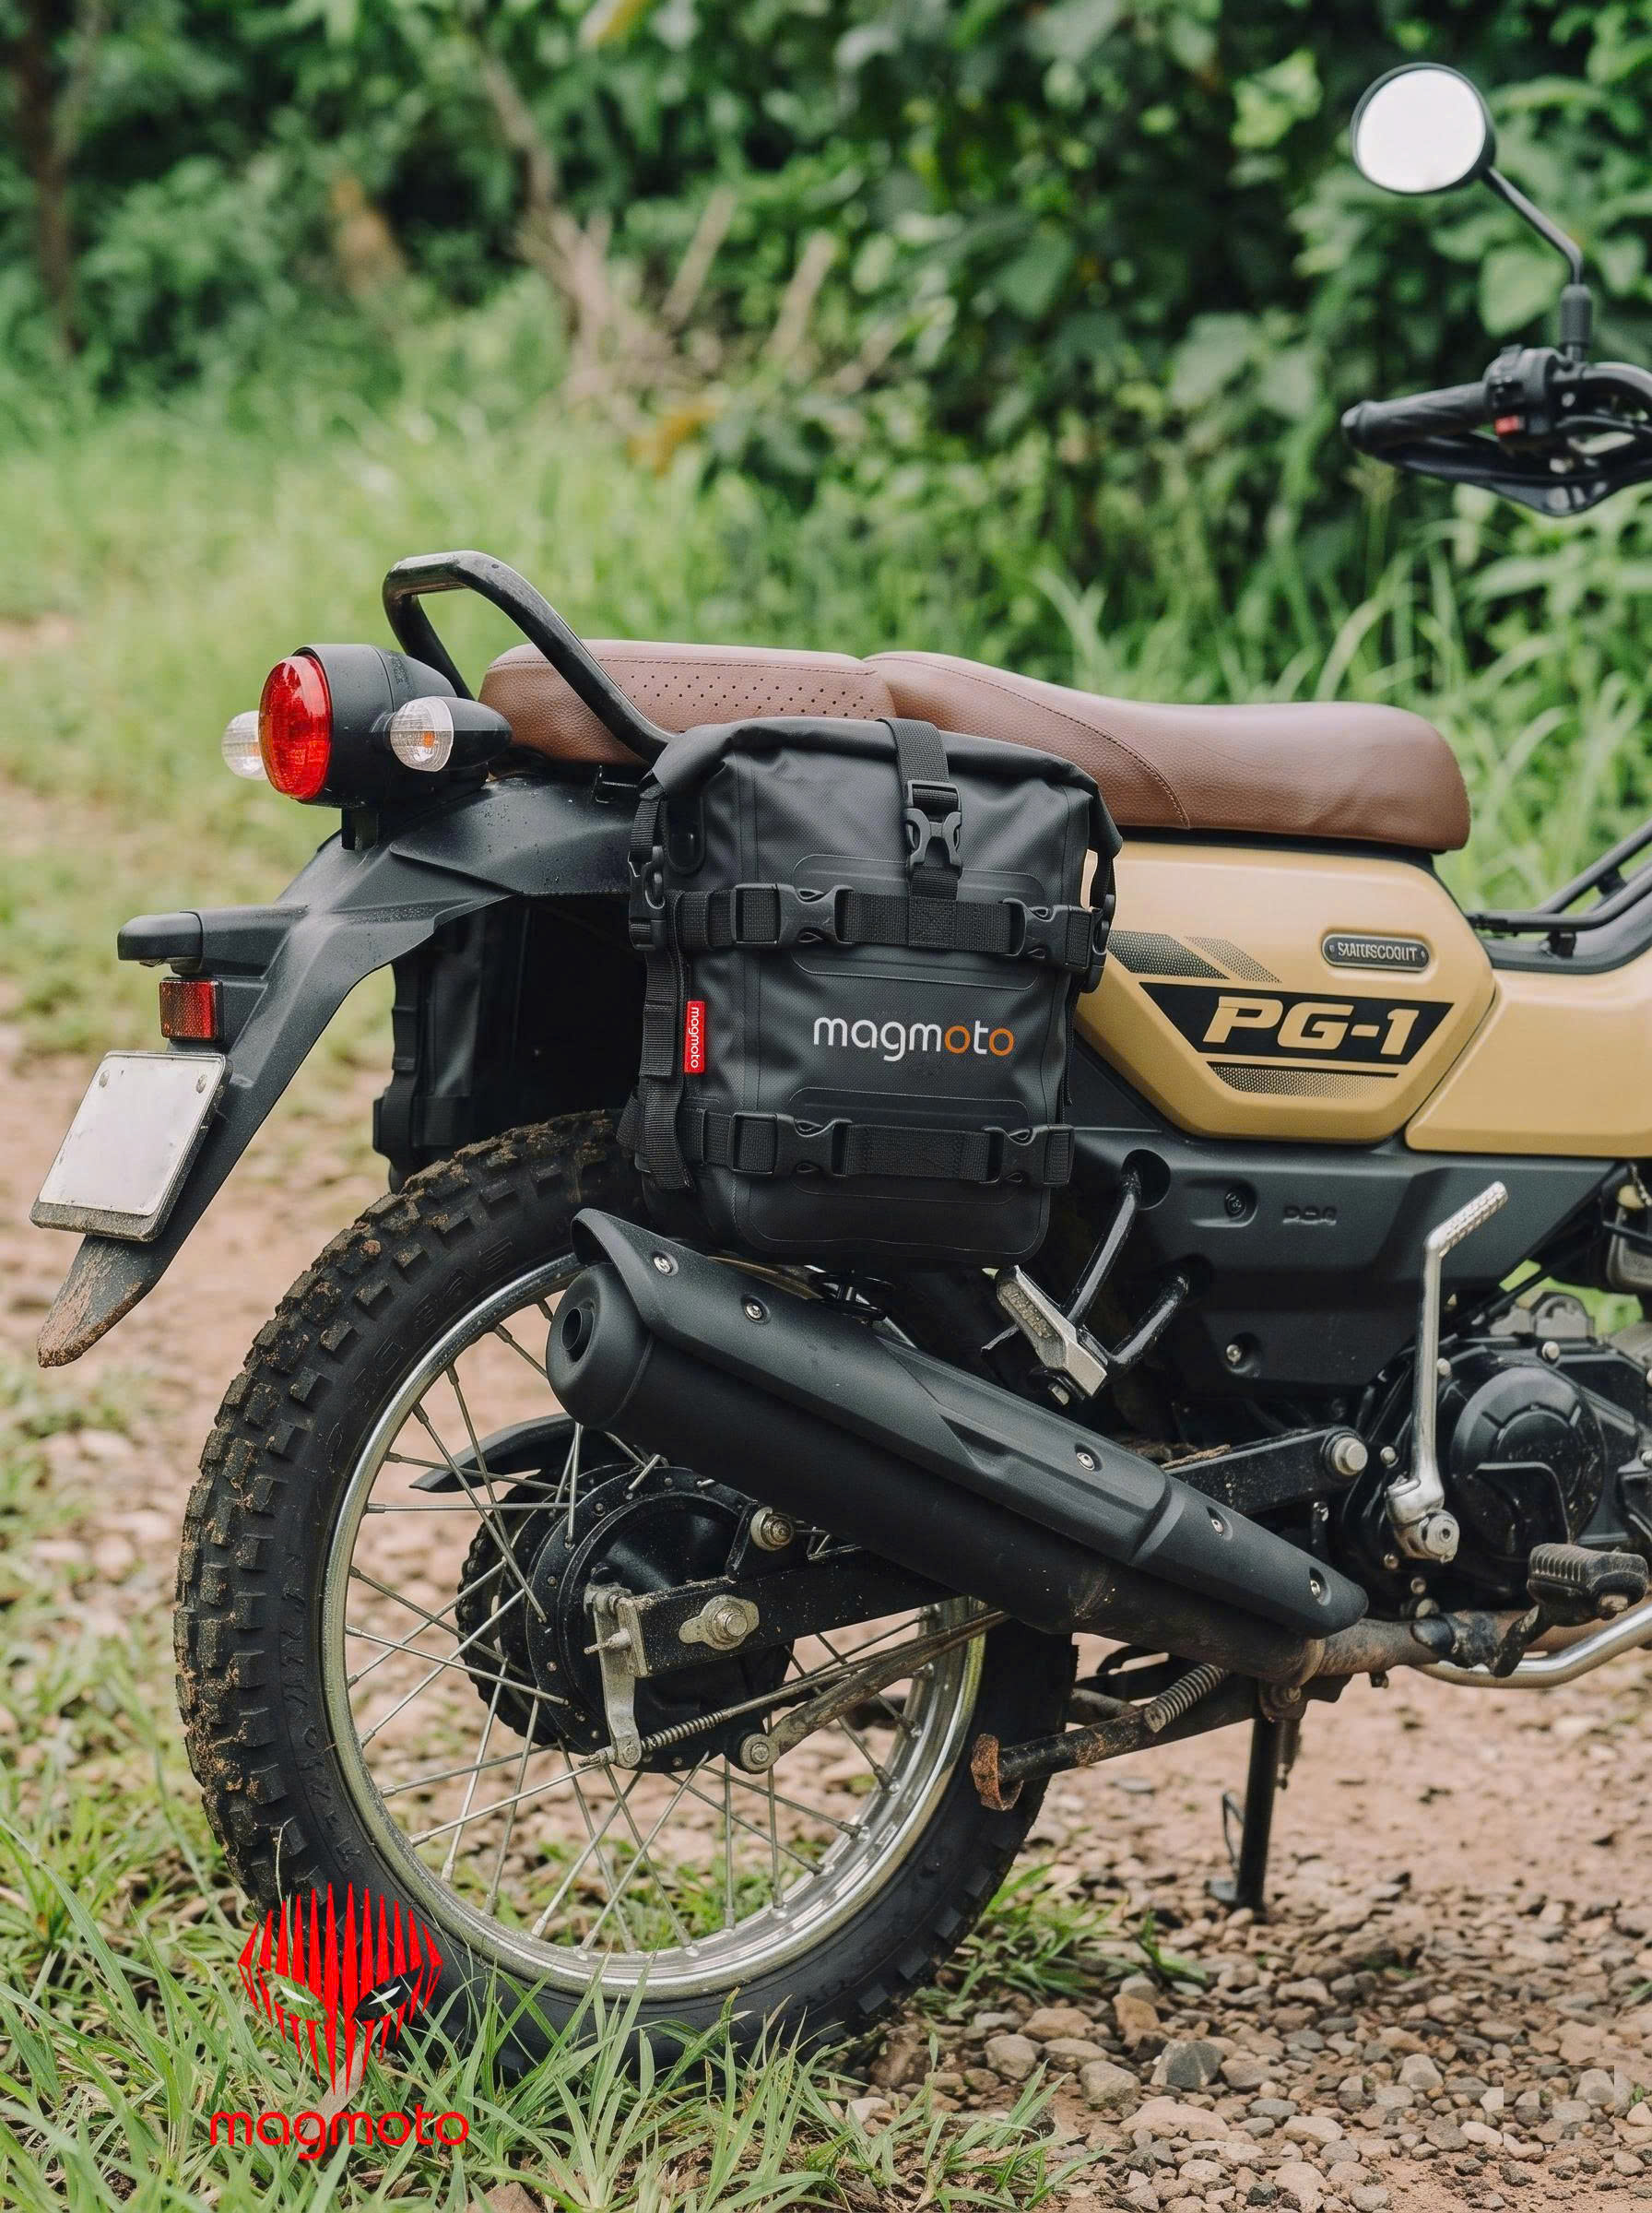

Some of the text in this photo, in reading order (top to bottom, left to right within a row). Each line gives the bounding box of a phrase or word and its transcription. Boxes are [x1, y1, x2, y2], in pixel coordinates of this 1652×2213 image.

[688, 1006, 701, 1069] magmoto
[813, 1017, 1014, 1061] magmoto
[1202, 995, 1421, 1056] PG-1
